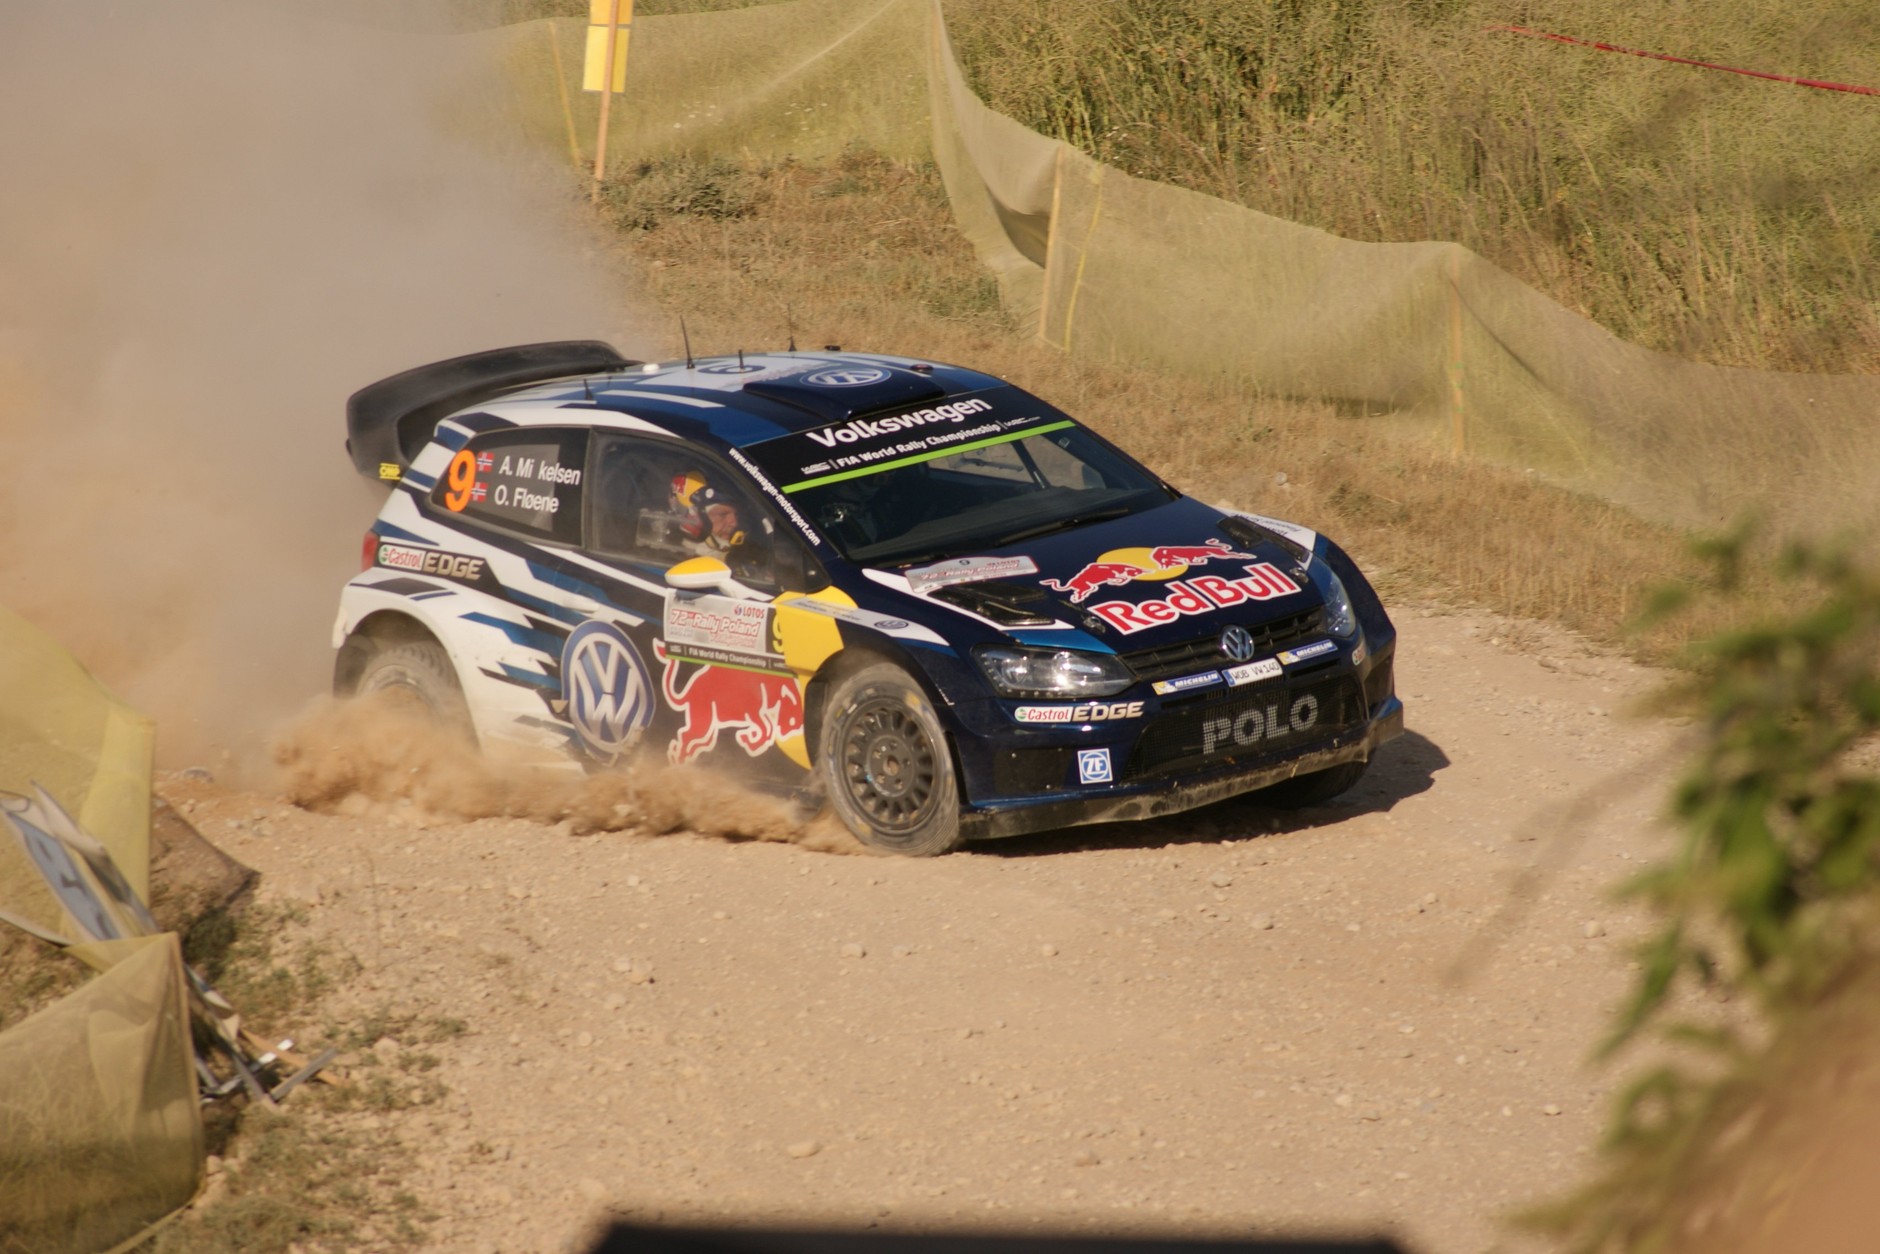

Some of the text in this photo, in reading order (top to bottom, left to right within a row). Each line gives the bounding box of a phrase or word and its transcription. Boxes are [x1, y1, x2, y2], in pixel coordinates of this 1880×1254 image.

[806, 398, 993, 447] Volkswagen
[836, 455, 862, 467] FIA
[858, 446, 897, 462] World
[896, 438, 928, 454] Rally
[926, 423, 1001, 446] Championship
[499, 455, 513, 476] A.
[445, 449, 476, 512] 9
[494, 484, 559, 513] O. Fløene
[729, 447, 821, 547] www.volkswagen-motorsport.com
[387, 548, 485, 580] Castrol EDGE
[1090, 563, 1299, 633] Red Bull
[692, 612, 721, 634] Rally
[720, 616, 761, 638] Poland
[743, 606, 766, 619] LOTOS
[1296, 641, 1333, 658] MICHELIN
[1174, 673, 1219, 688] MICHELIN
[1232, 670, 1248, 681] WOB
[1027, 701, 1145, 722] Castrol EDGE
[1203, 693, 1319, 755] POLO
[1084, 757, 1107, 774] ZF
